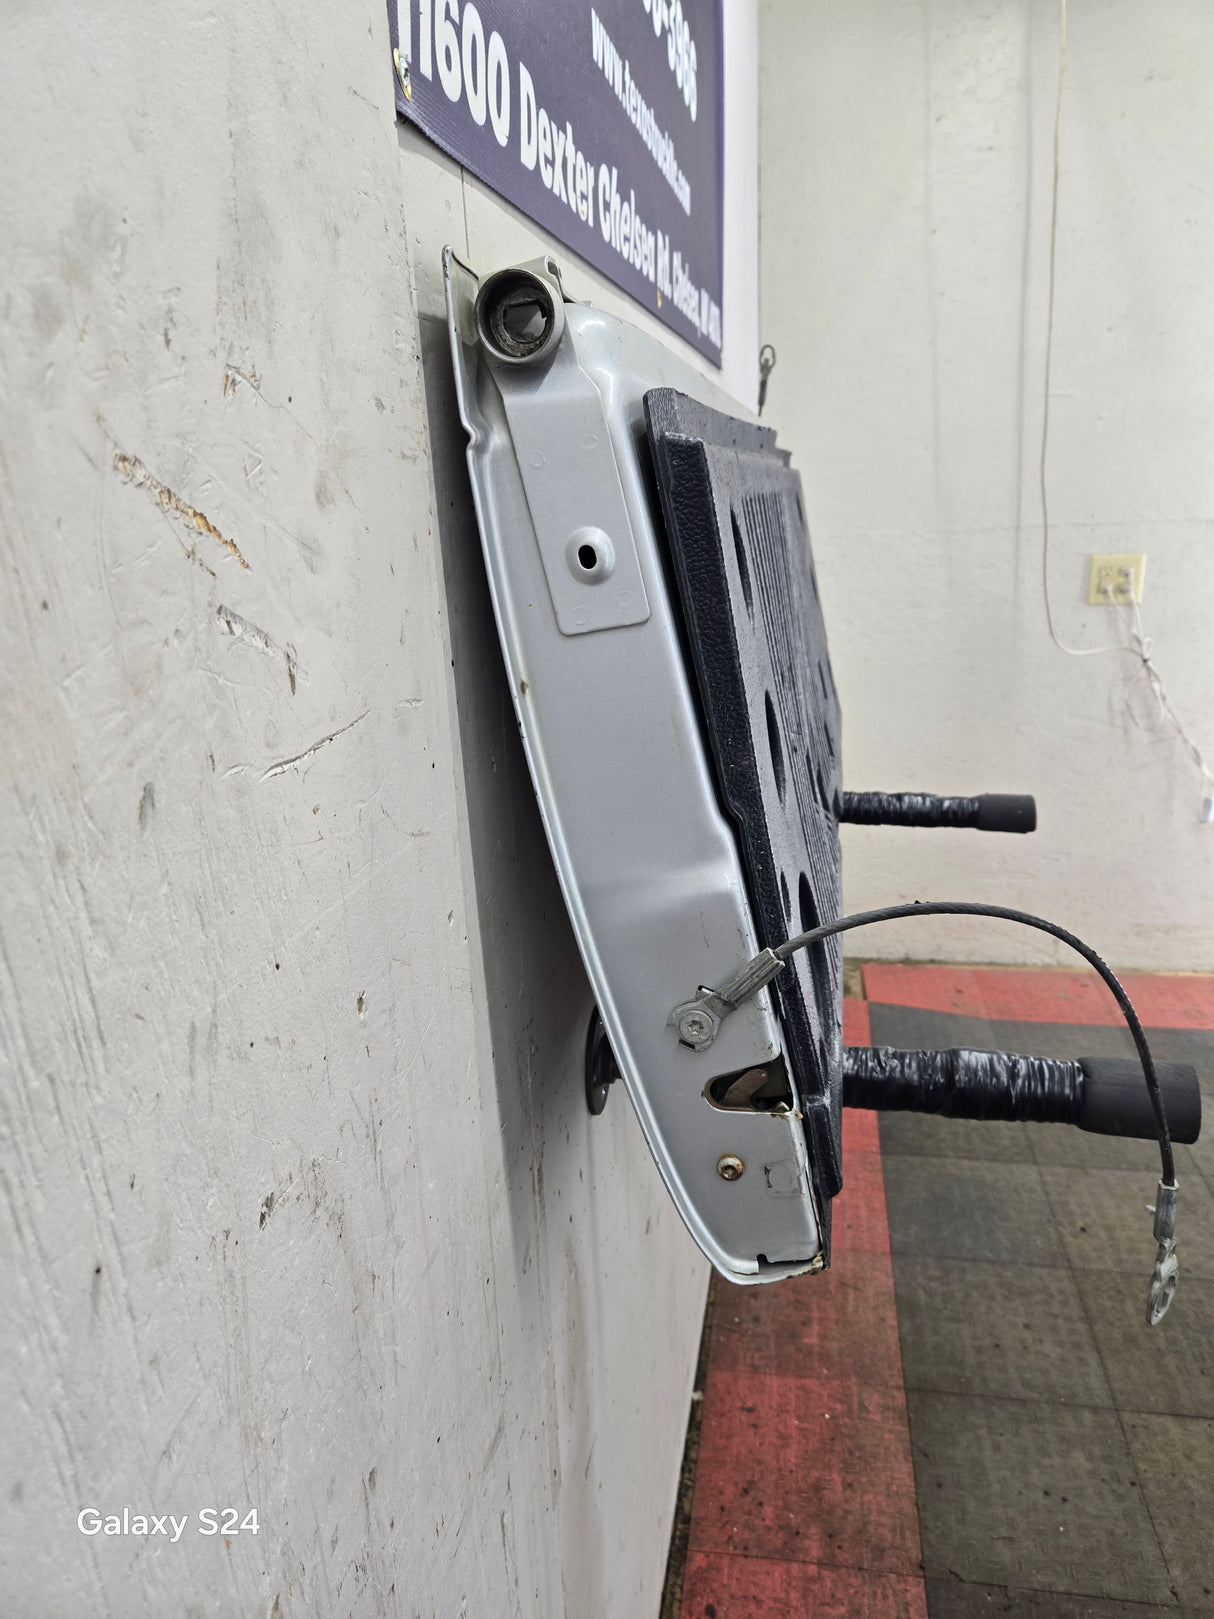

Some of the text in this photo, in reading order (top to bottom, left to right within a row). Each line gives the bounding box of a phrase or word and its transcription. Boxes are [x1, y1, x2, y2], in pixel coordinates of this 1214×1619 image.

[643, 0, 697, 122] -3966
[520, 61, 594, 228] Dexter
[598, 163, 655, 284] Chelsea
[657, 230, 672, 300] Rd.
